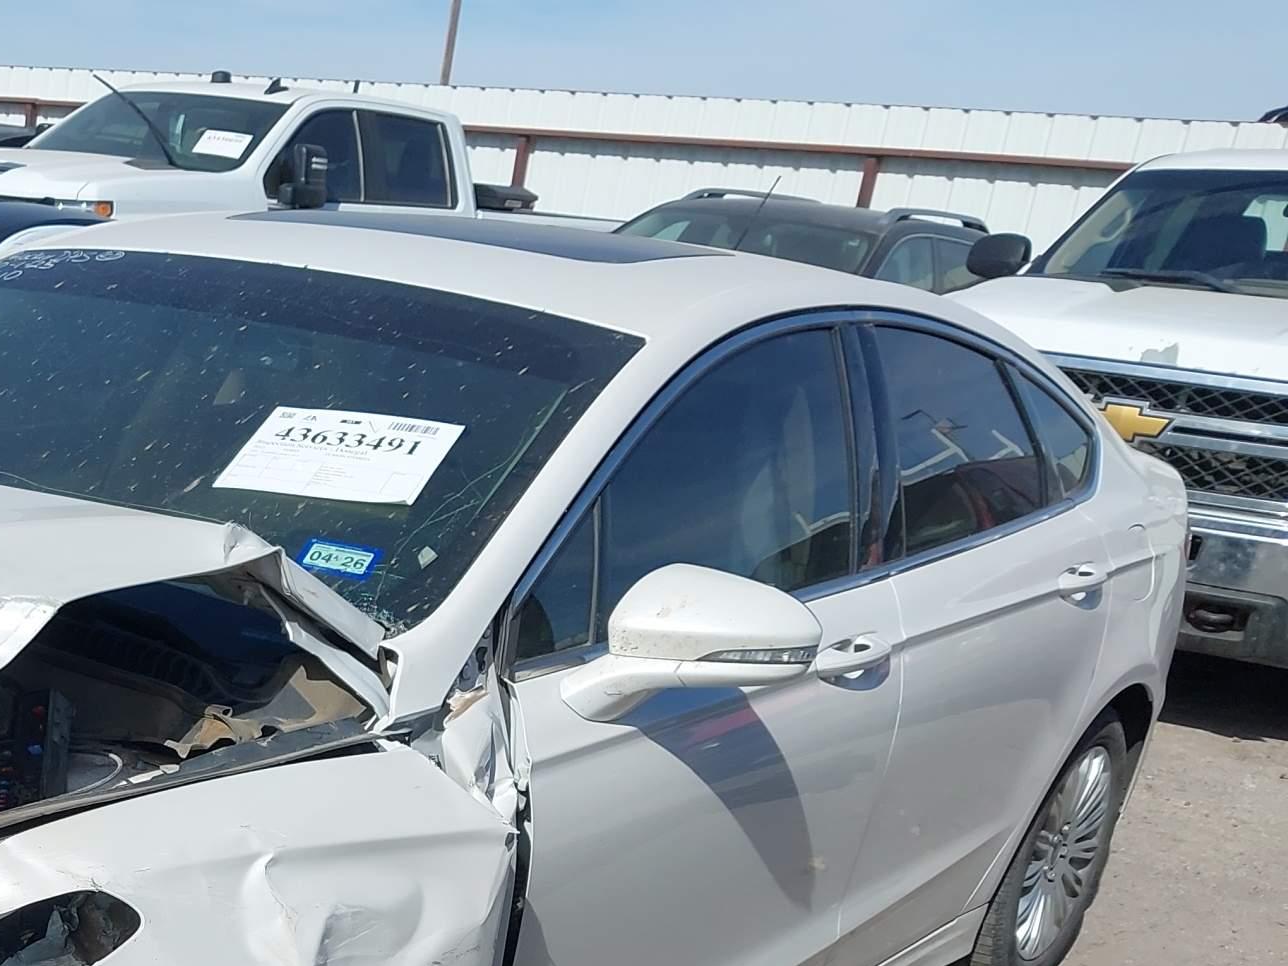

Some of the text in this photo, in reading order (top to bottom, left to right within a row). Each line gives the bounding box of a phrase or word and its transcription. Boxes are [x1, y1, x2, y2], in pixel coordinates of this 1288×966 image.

[275, 426, 422, 456] 43633491
[309, 550, 332, 564] 04
[341, 556, 366, 570] 26
